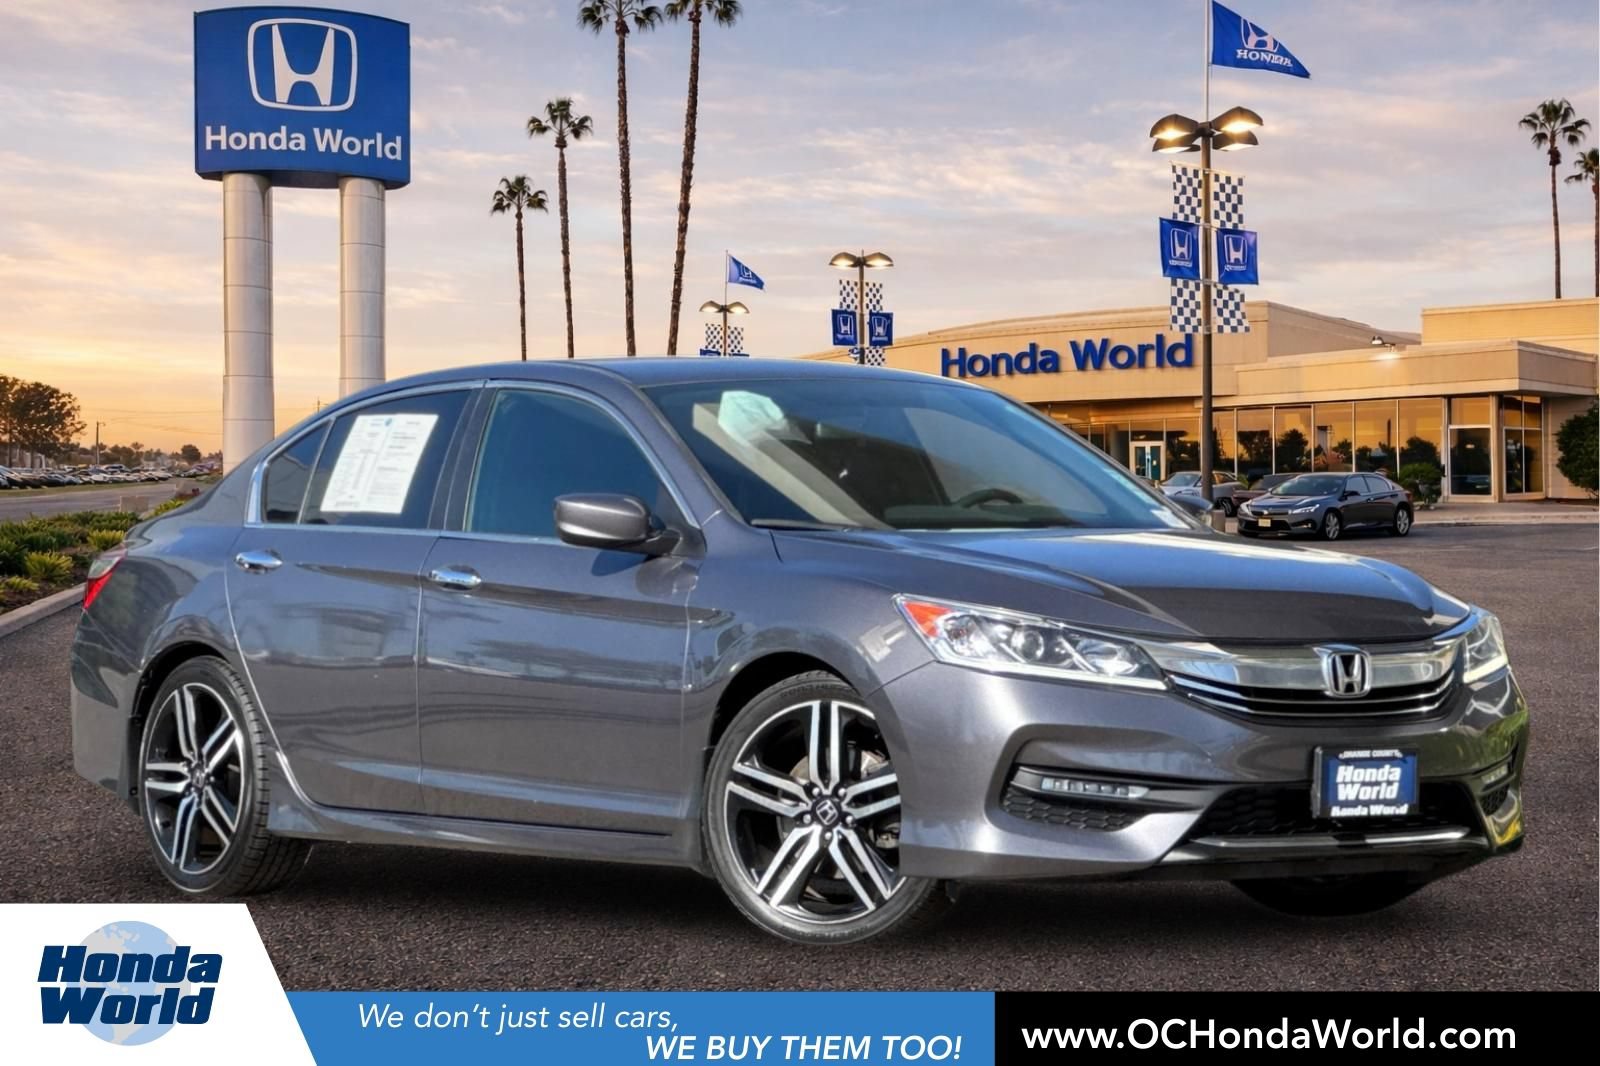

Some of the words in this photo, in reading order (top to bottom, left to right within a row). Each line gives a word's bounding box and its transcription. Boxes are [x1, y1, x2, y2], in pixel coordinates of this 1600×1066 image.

[205, 125, 306, 151] Honda
[313, 127, 402, 161] World
[941, 342, 1062, 378] Honda
[1069, 333, 1195, 372] World
[1336, 764, 1402, 783] Honda
[1337, 782, 1400, 801] World
[1330, 805, 1369, 817] Honda
